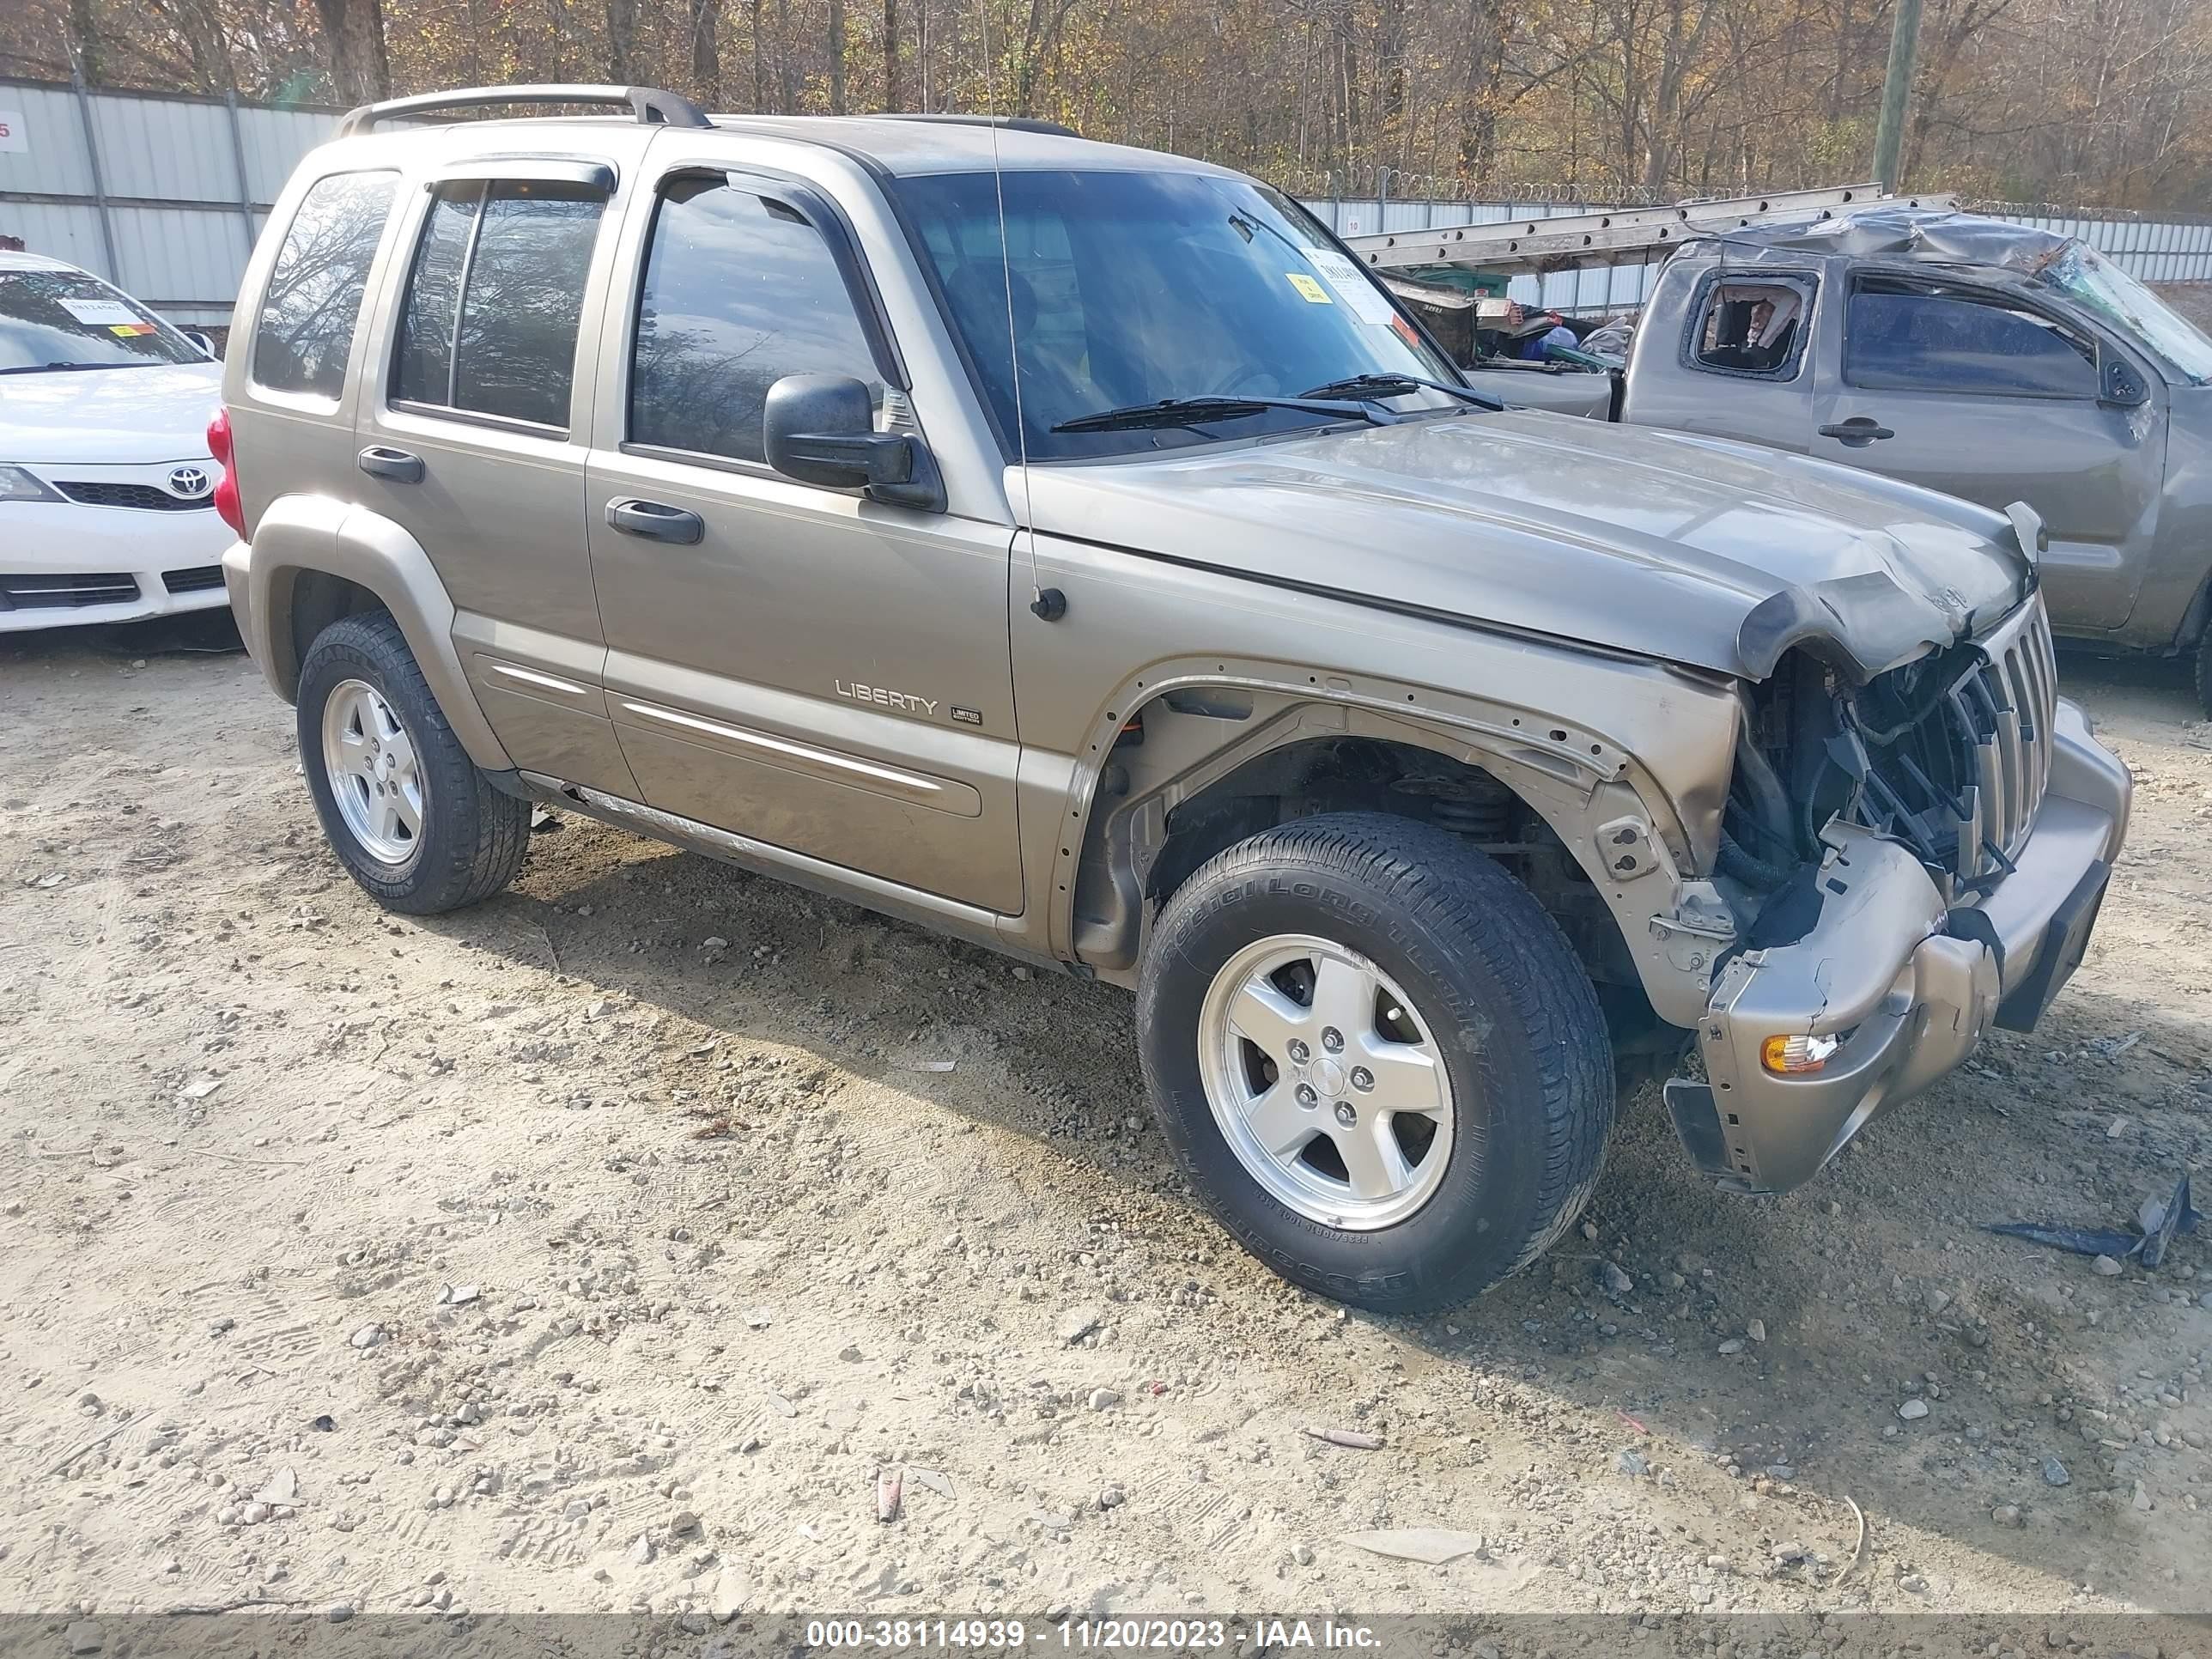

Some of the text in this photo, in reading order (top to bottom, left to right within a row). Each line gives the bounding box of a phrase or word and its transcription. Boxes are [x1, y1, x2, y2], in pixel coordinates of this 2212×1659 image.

[1350, 222, 1358, 230] 10
[835, 679, 939, 715] LIBERTY
[952, 708, 979, 719] LIMITED
[1268, 877, 1381, 928] Long
